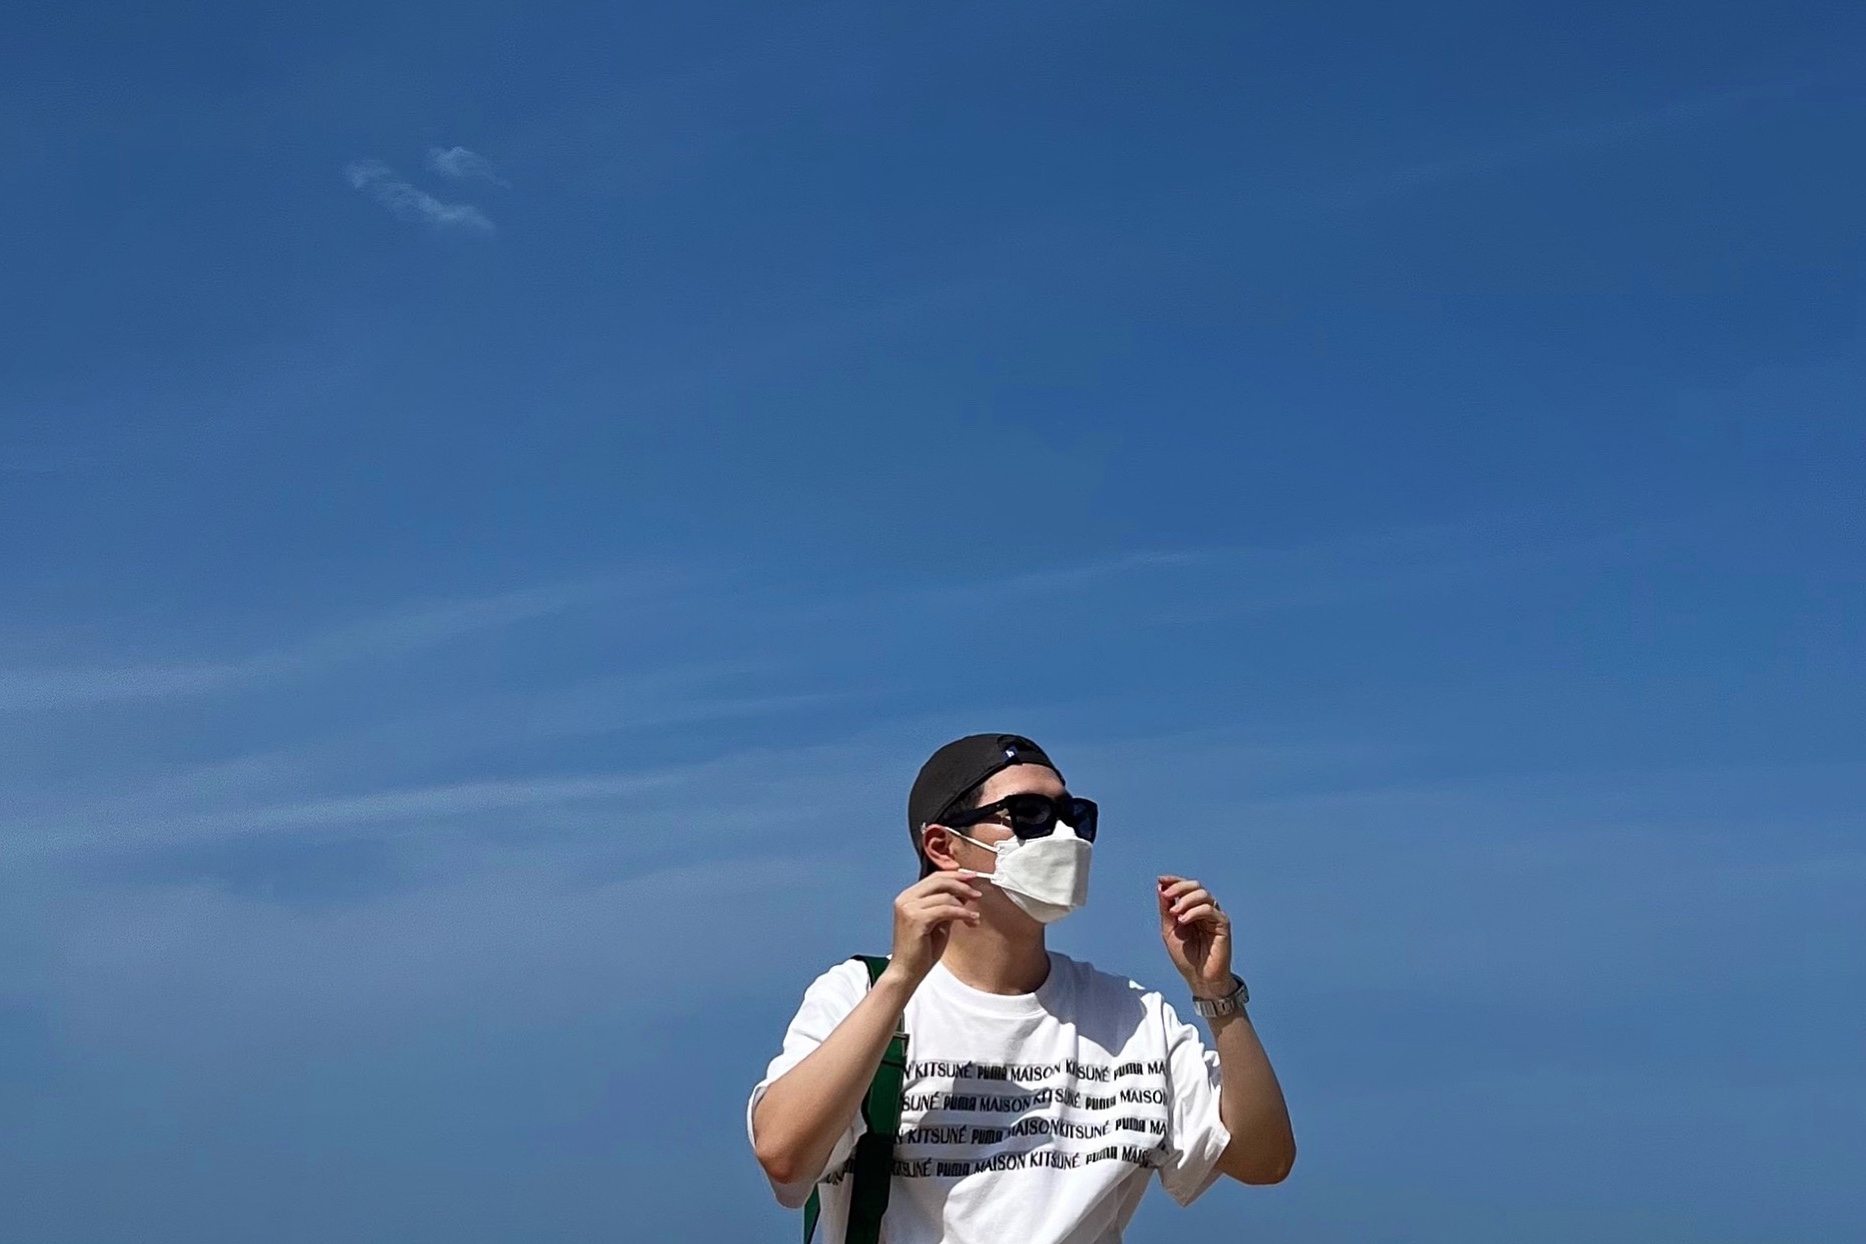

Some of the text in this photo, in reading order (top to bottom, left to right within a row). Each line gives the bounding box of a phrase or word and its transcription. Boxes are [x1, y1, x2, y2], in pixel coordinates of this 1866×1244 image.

[916, 1061, 973, 1078] KITSUNÉ
[1011, 1064, 1060, 1081] MAISON
[980, 1097, 1030, 1112] MAISON
[908, 1126, 967, 1144] KITSUNÉ
[1059, 1120, 1109, 1139] KITSUNÉ
[974, 1154, 1025, 1173] MAISON
[1030, 1151, 1080, 1170] KITSUNÉ
